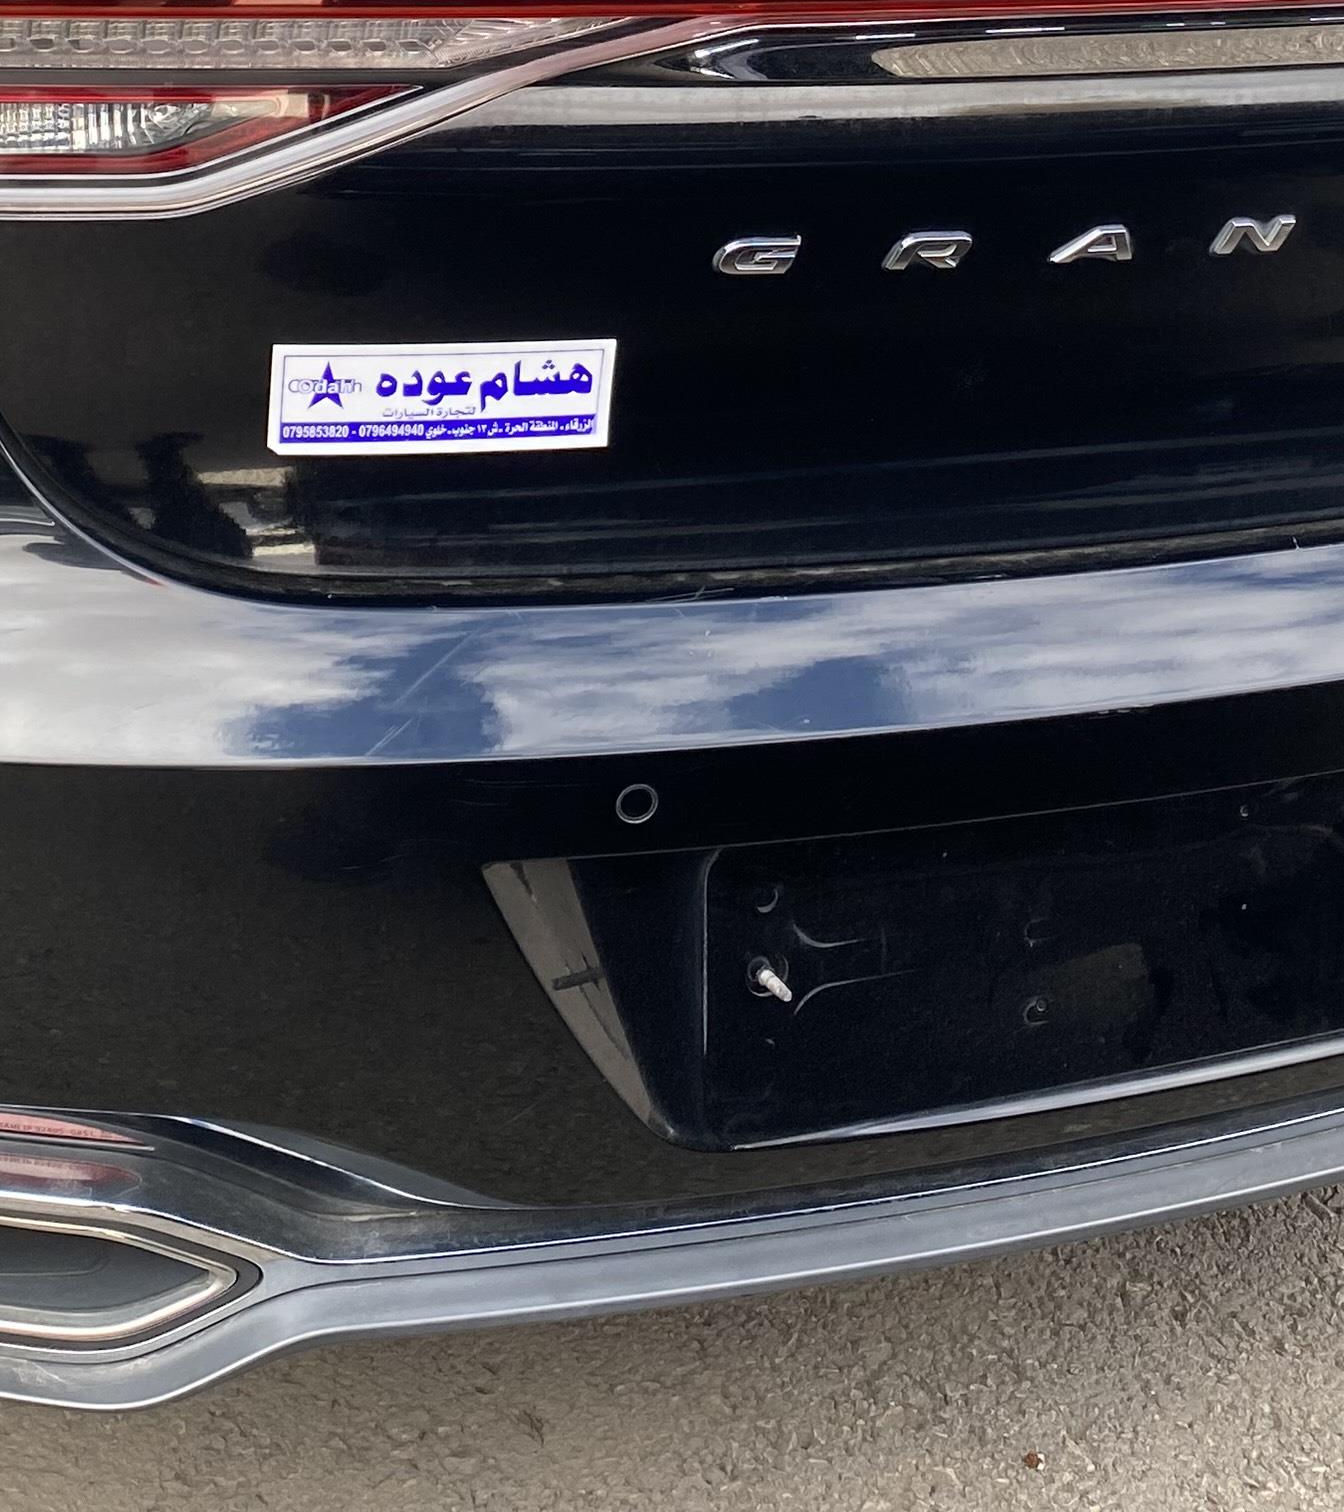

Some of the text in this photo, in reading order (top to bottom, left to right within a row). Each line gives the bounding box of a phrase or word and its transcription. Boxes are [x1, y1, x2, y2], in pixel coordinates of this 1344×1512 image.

[375, 360, 593, 413] هشام عوده
[381, 406, 476, 420] لتجارة السيارات
[358, 423, 424, 438] 0796494940
